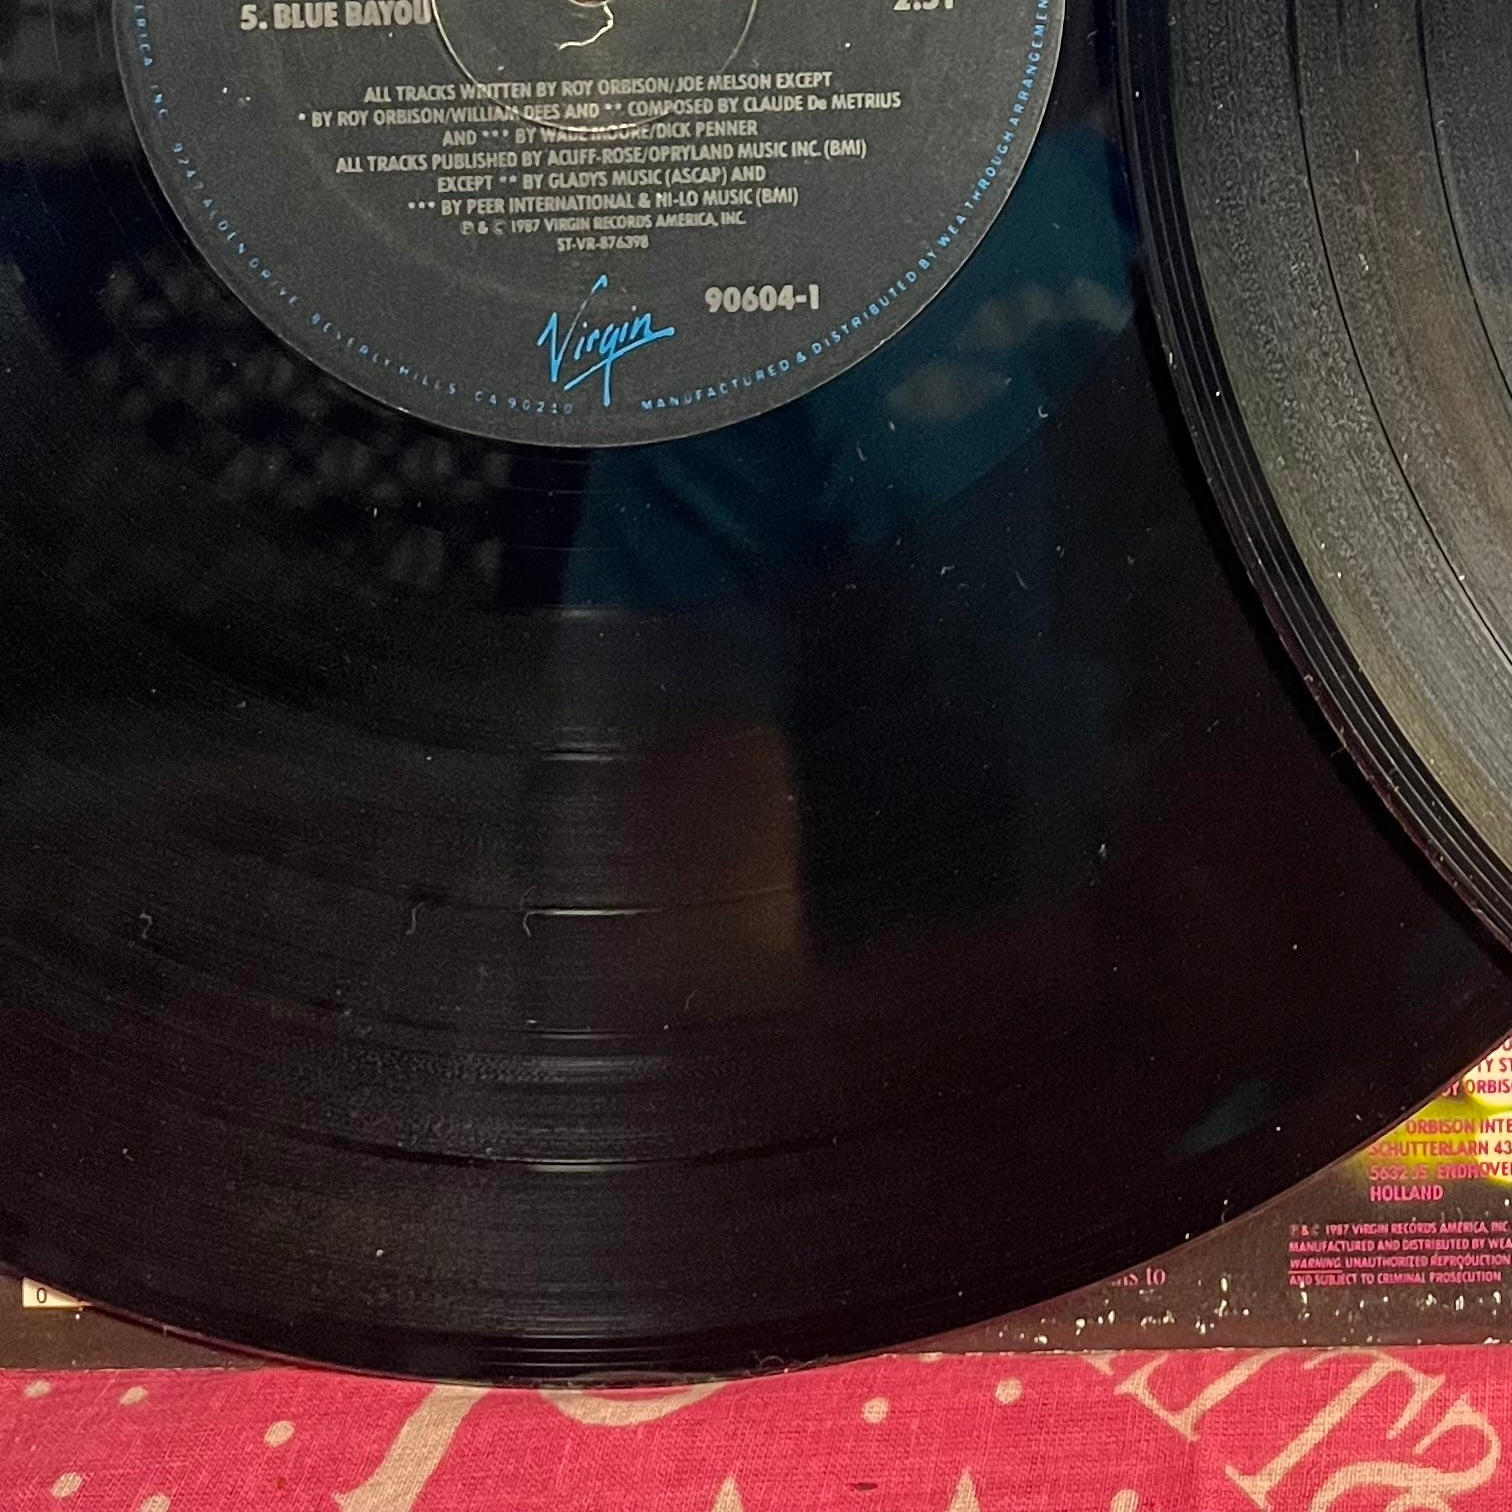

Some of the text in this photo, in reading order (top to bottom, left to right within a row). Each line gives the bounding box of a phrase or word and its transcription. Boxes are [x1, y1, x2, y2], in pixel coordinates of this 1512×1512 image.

[240, 4, 268, 30] 5.
[273, 1, 339, 29] BLUE
[396, 72, 832, 102] TRACKS MELSON EXCEPT
[628, 92, 902, 117] COMPOSED CLAUDE METRIUS
[695, 120, 758, 138] PENNER
[367, 142, 788, 173] TRACKS PUBLISHED MUSIC
[438, 168, 663, 193] EXCEPT MUSIC
[702, 188, 753, 206] MUSIC
[704, 284, 820, 313] 90604-1
[537, 274, 675, 407] Virgin
[1406, 1118, 1474, 1134] ORBISON
[1494, 1140, 1512, 1155] 43
[1369, 1185, 1444, 1202] HOLLAND
[1391, 1222, 1437, 1234] RECORDS
[1289, 1240, 1374, 1253] MANUFACTURED
[1377, 1240, 1400, 1251] AND
[1402, 1238, 1469, 1251] DISTRIBUTED
[1472, 1238, 1486, 1250] BY
